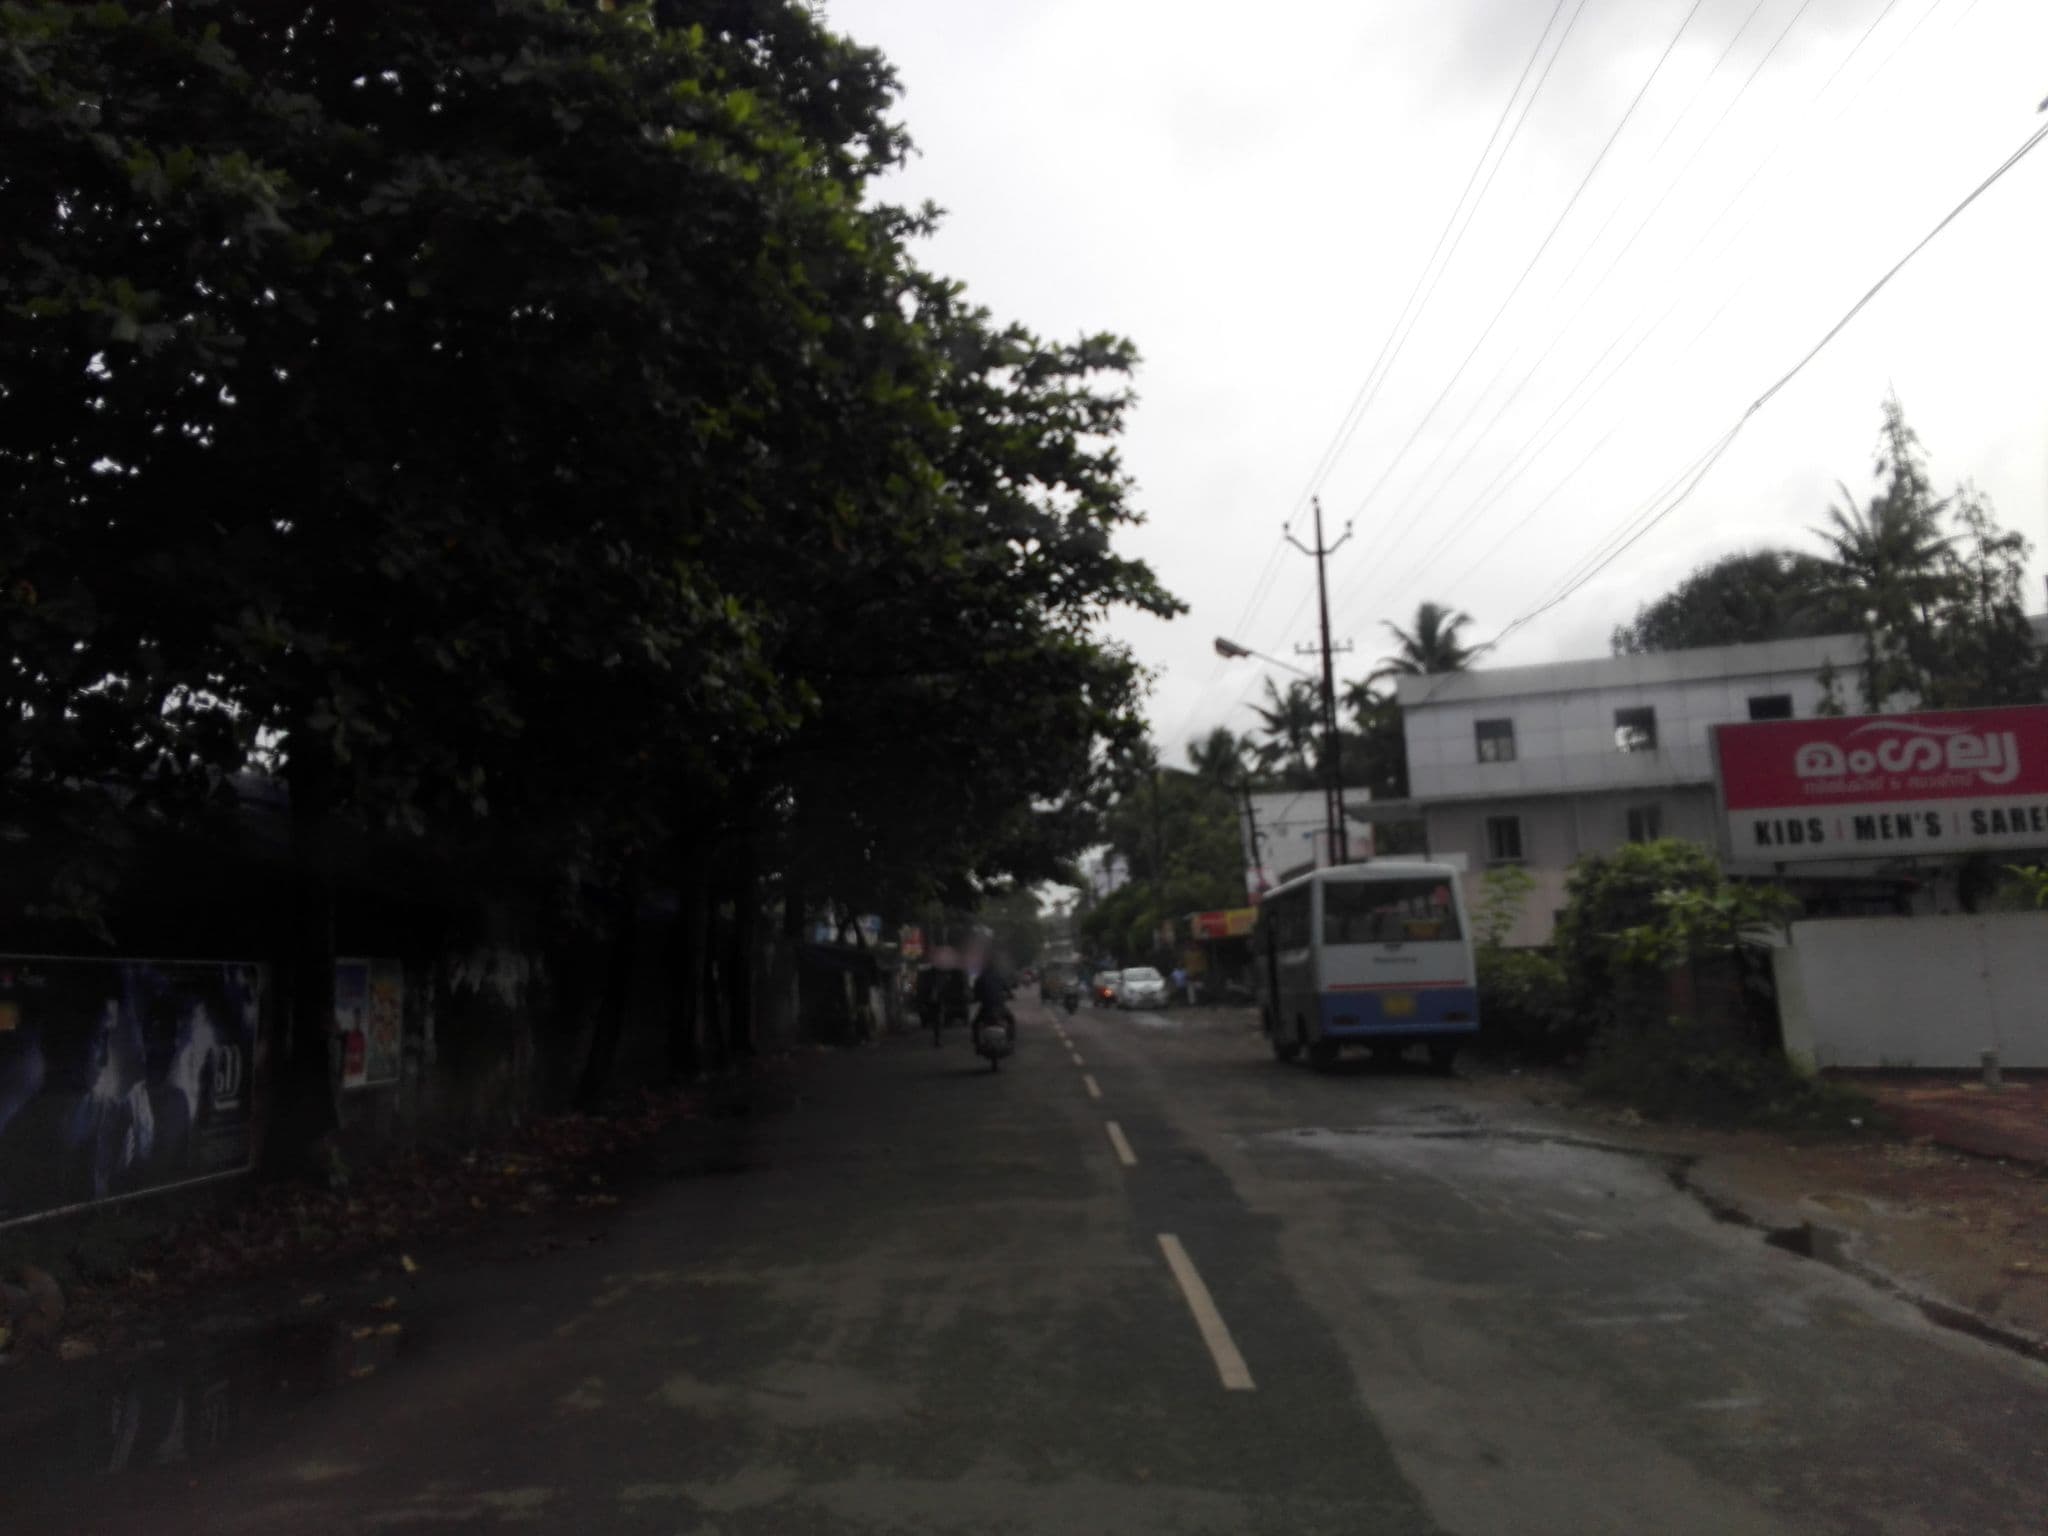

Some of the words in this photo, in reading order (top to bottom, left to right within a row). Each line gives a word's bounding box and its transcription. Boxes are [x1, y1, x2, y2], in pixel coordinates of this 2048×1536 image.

[1755, 819, 1823, 846] KIDS
[1854, 812, 1941, 840] MEN'S
[1970, 807, 2048, 835] SARE
